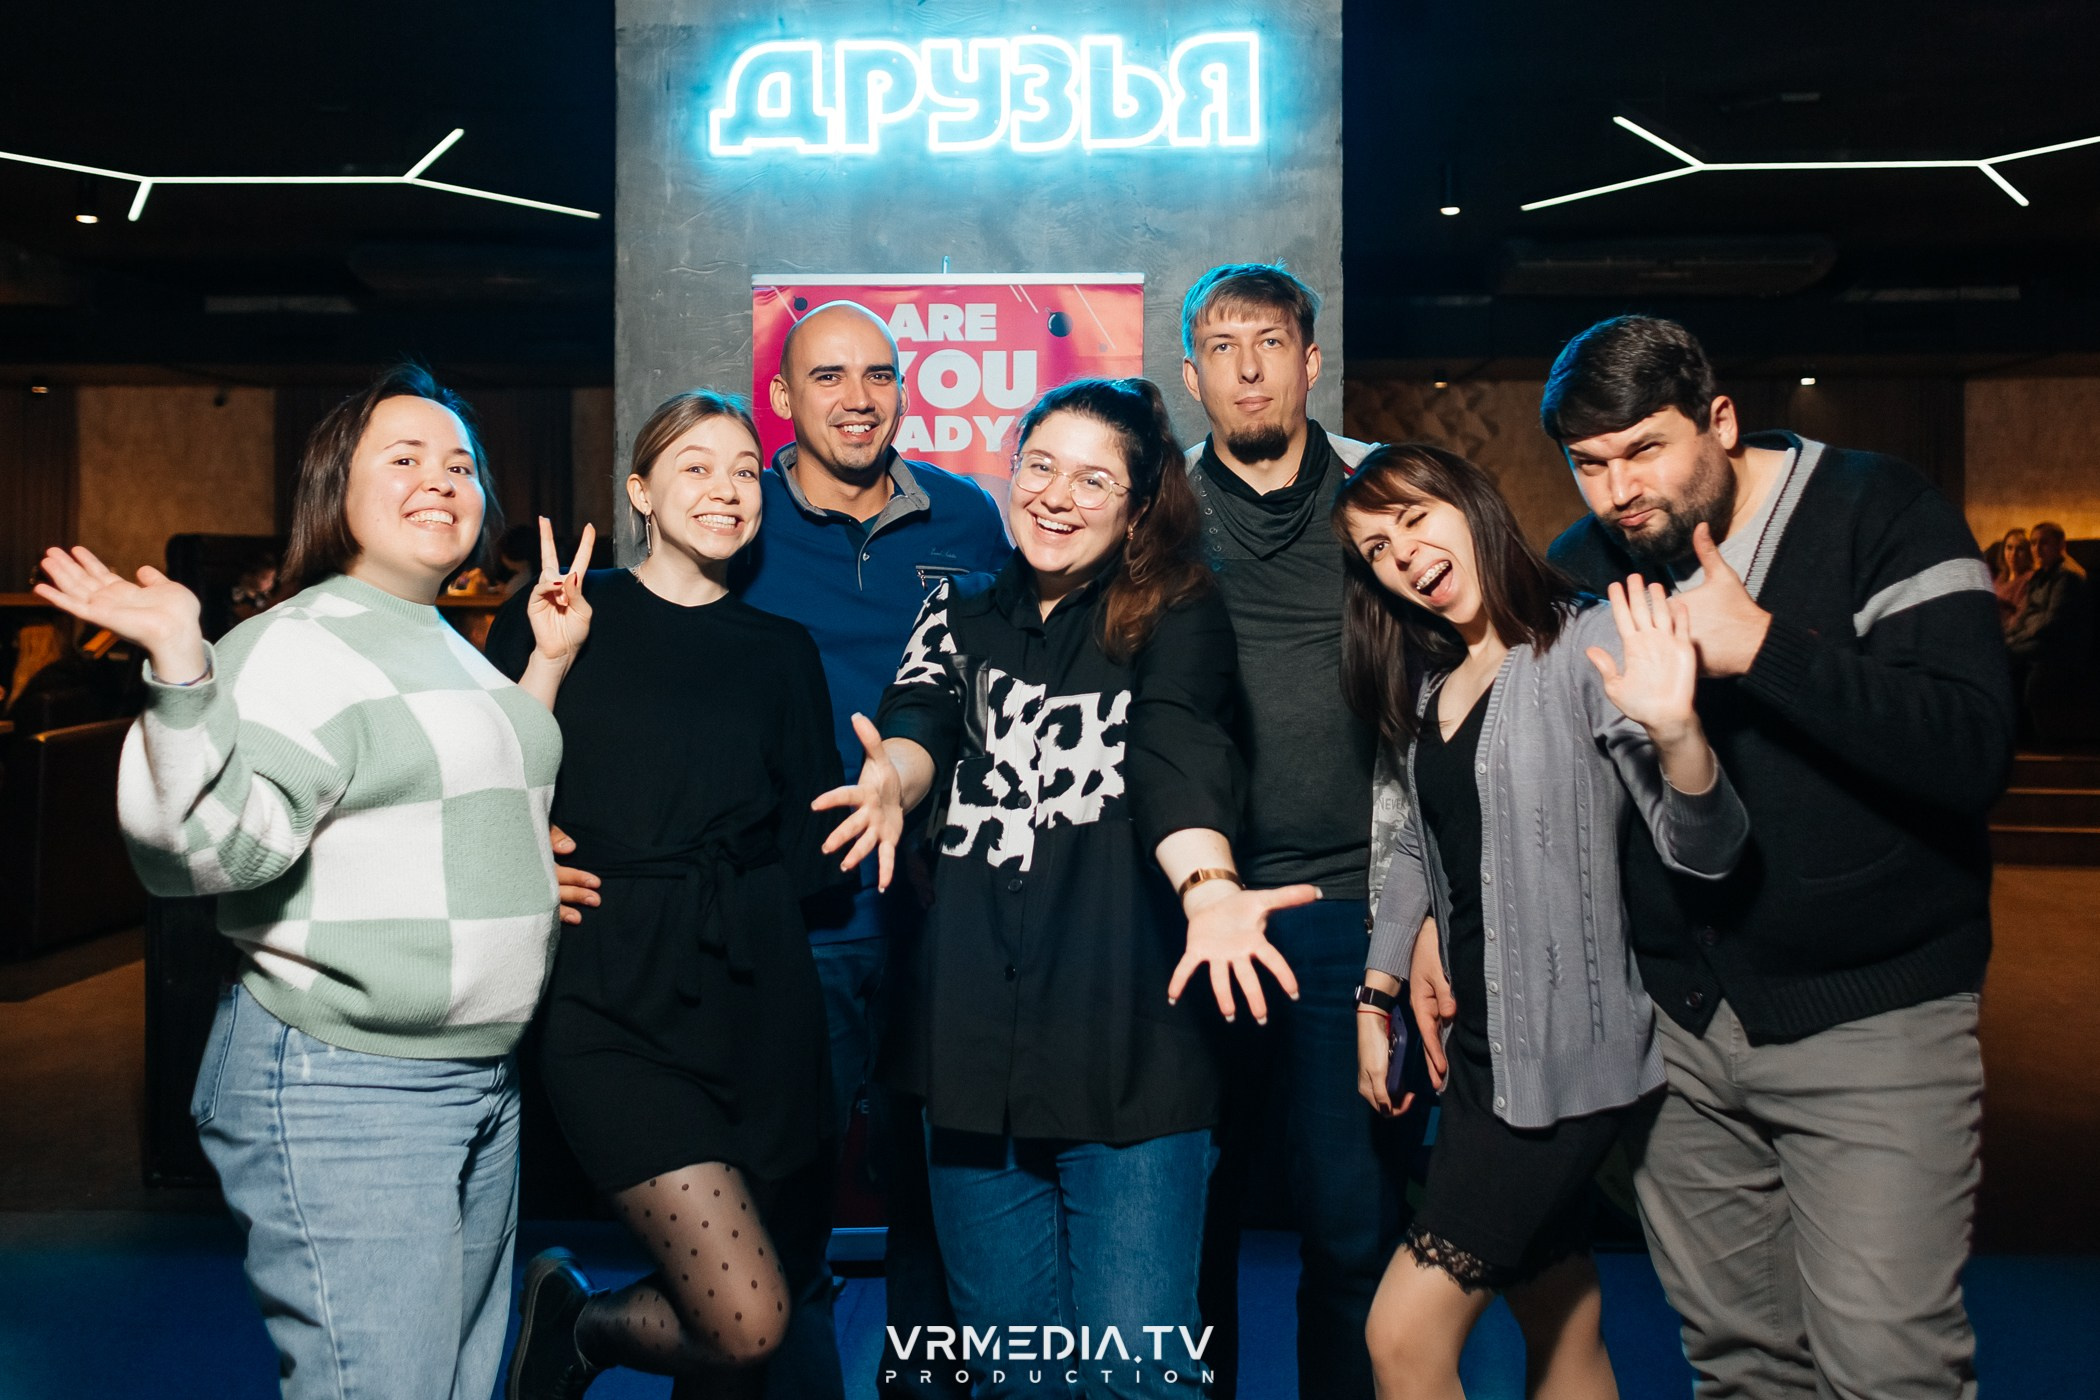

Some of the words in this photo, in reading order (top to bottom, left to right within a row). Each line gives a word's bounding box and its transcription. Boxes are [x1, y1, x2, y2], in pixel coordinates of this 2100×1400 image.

[709, 31, 1261, 157] ДРУЗЬЯ
[887, 303, 997, 342] ARE
[899, 348, 1037, 410] OU
[892, 415, 1015, 453] ADY
